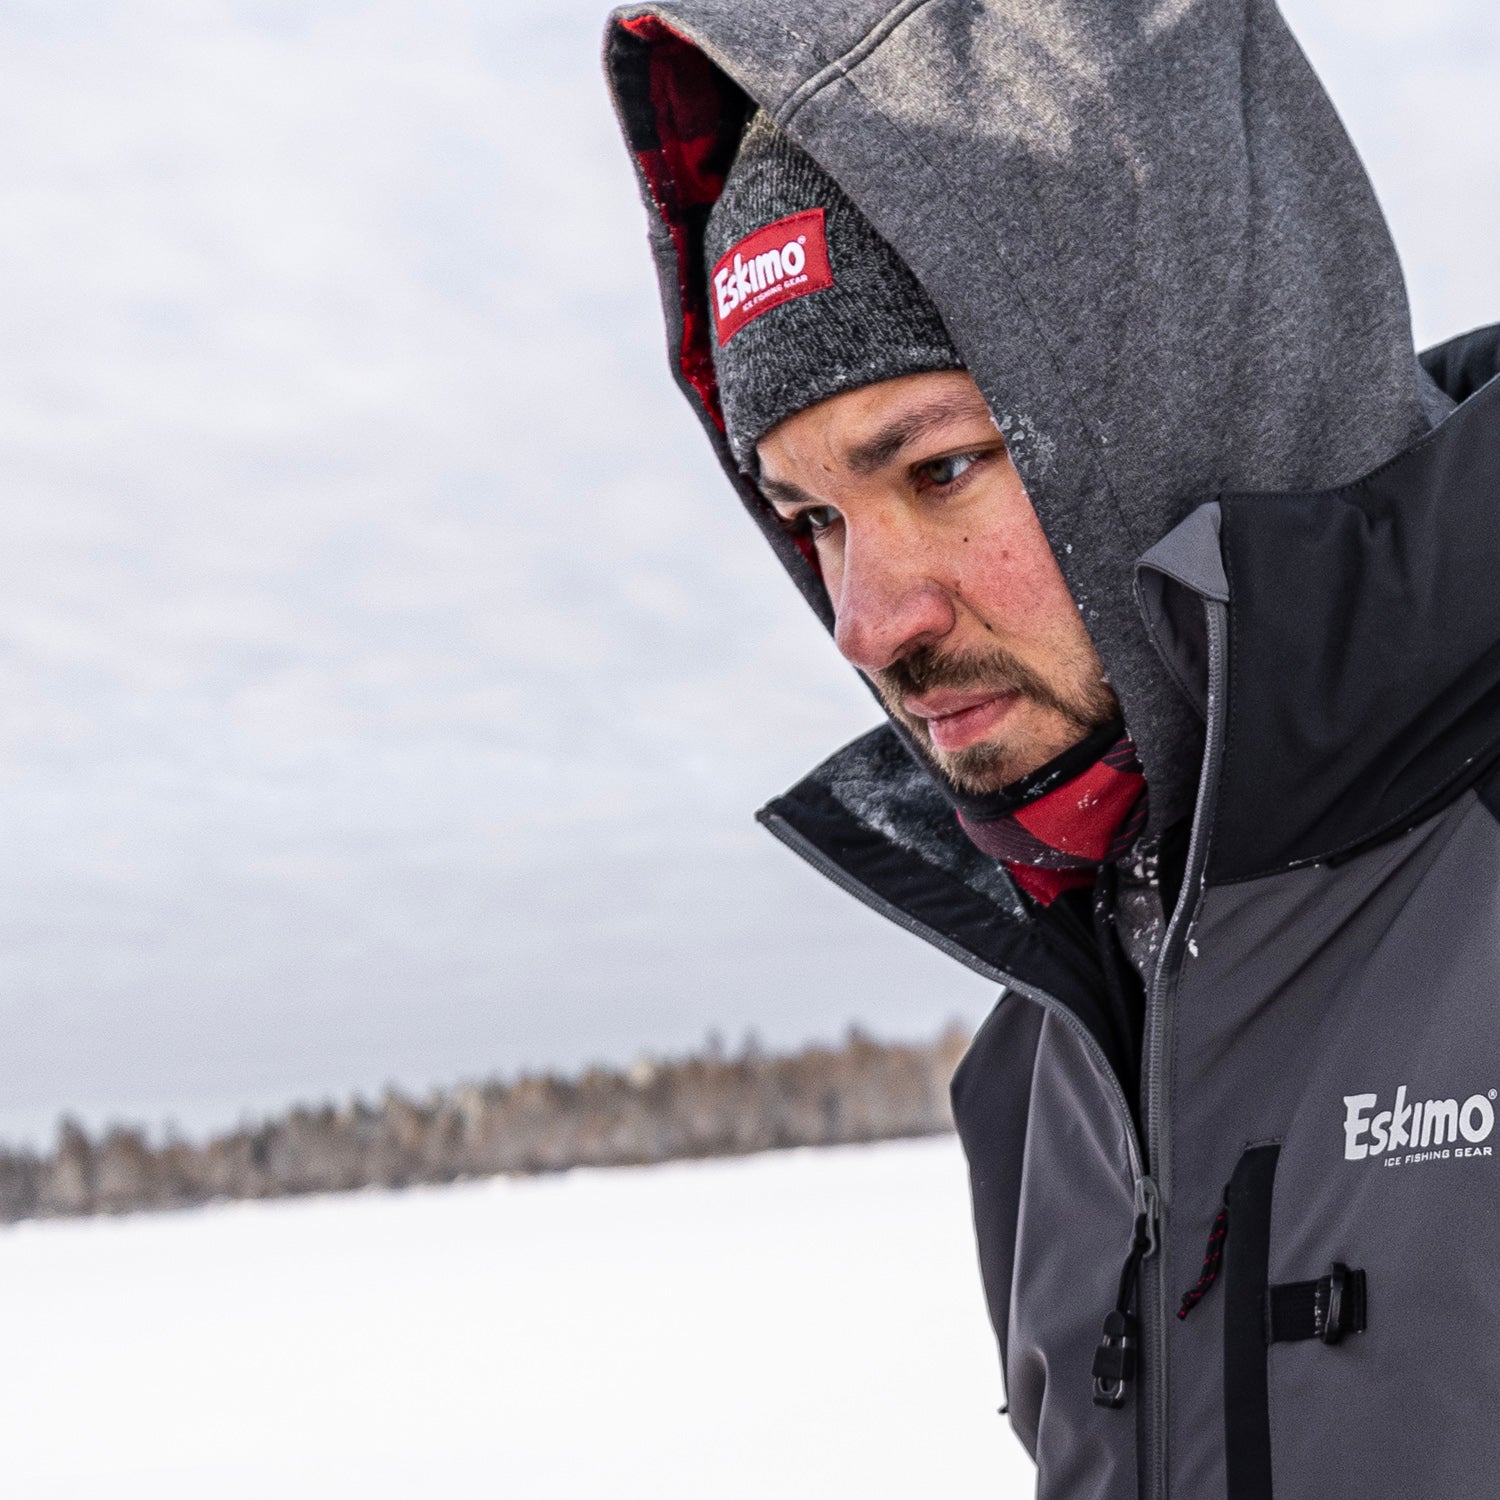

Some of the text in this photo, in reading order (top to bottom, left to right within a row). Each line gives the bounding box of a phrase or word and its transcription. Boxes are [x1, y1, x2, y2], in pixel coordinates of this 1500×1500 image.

[1342, 1084, 1496, 1161] Eskimo
[1384, 1146, 1493, 1168] ICE FISHING GEAR
